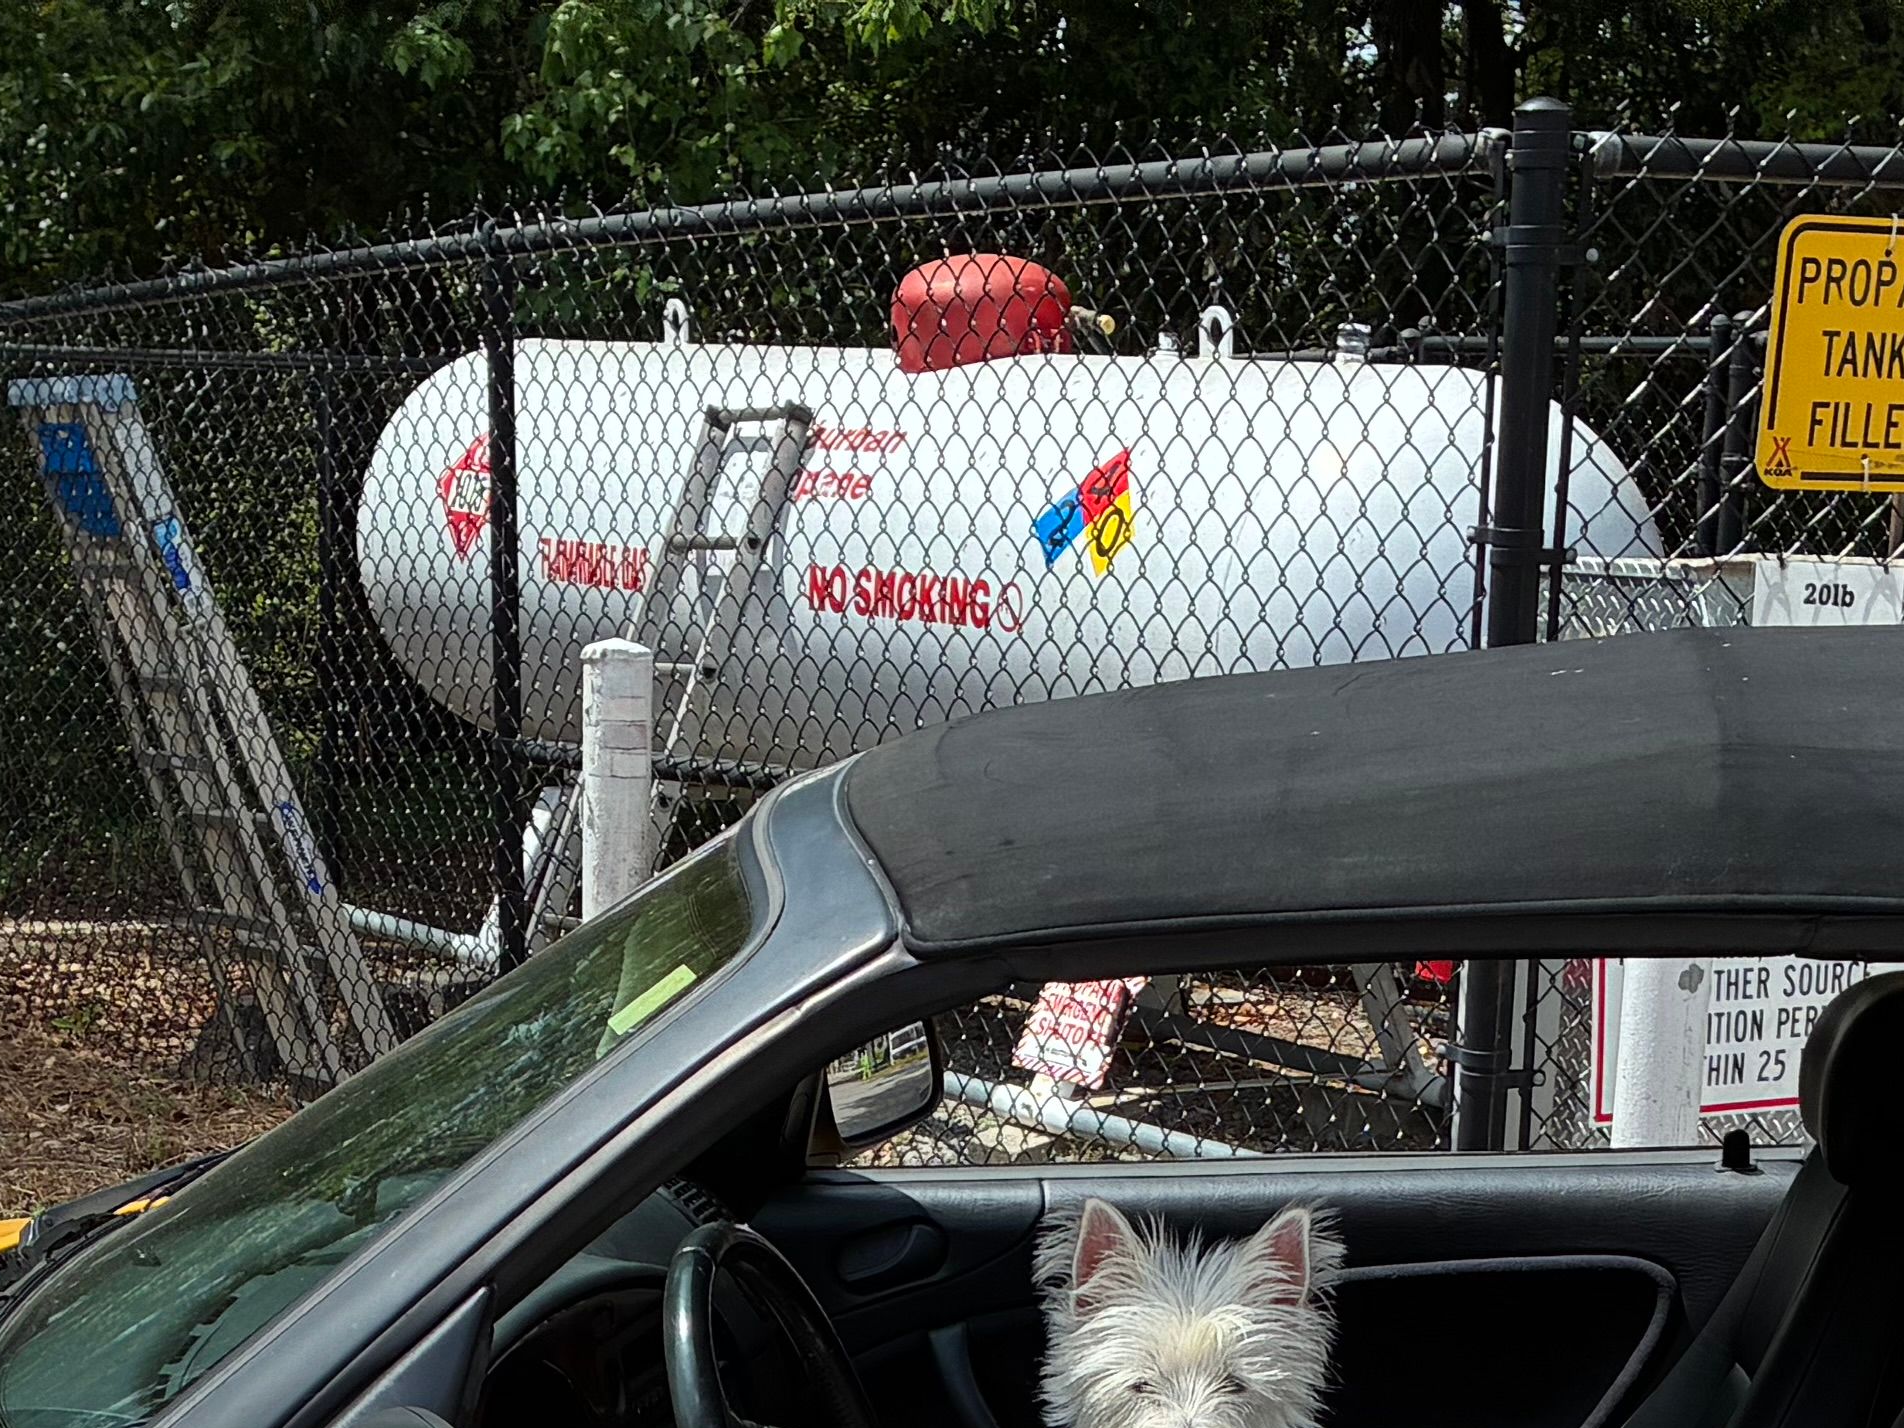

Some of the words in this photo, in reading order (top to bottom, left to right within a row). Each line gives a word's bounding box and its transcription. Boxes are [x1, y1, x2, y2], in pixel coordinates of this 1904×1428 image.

[1763, 468, 1793, 479] KOA
[1096, 507, 1124, 557] 0
[808, 562, 847, 613] NO
[853, 568, 991, 629] SMOKING
[1714, 967, 1770, 1001] THER
[1783, 963, 1868, 997] SOURC
[1707, 1009, 1764, 1044] ITION
[1704, 1053, 1745, 1086] HIN
[1757, 1049, 1786, 1082] 25
